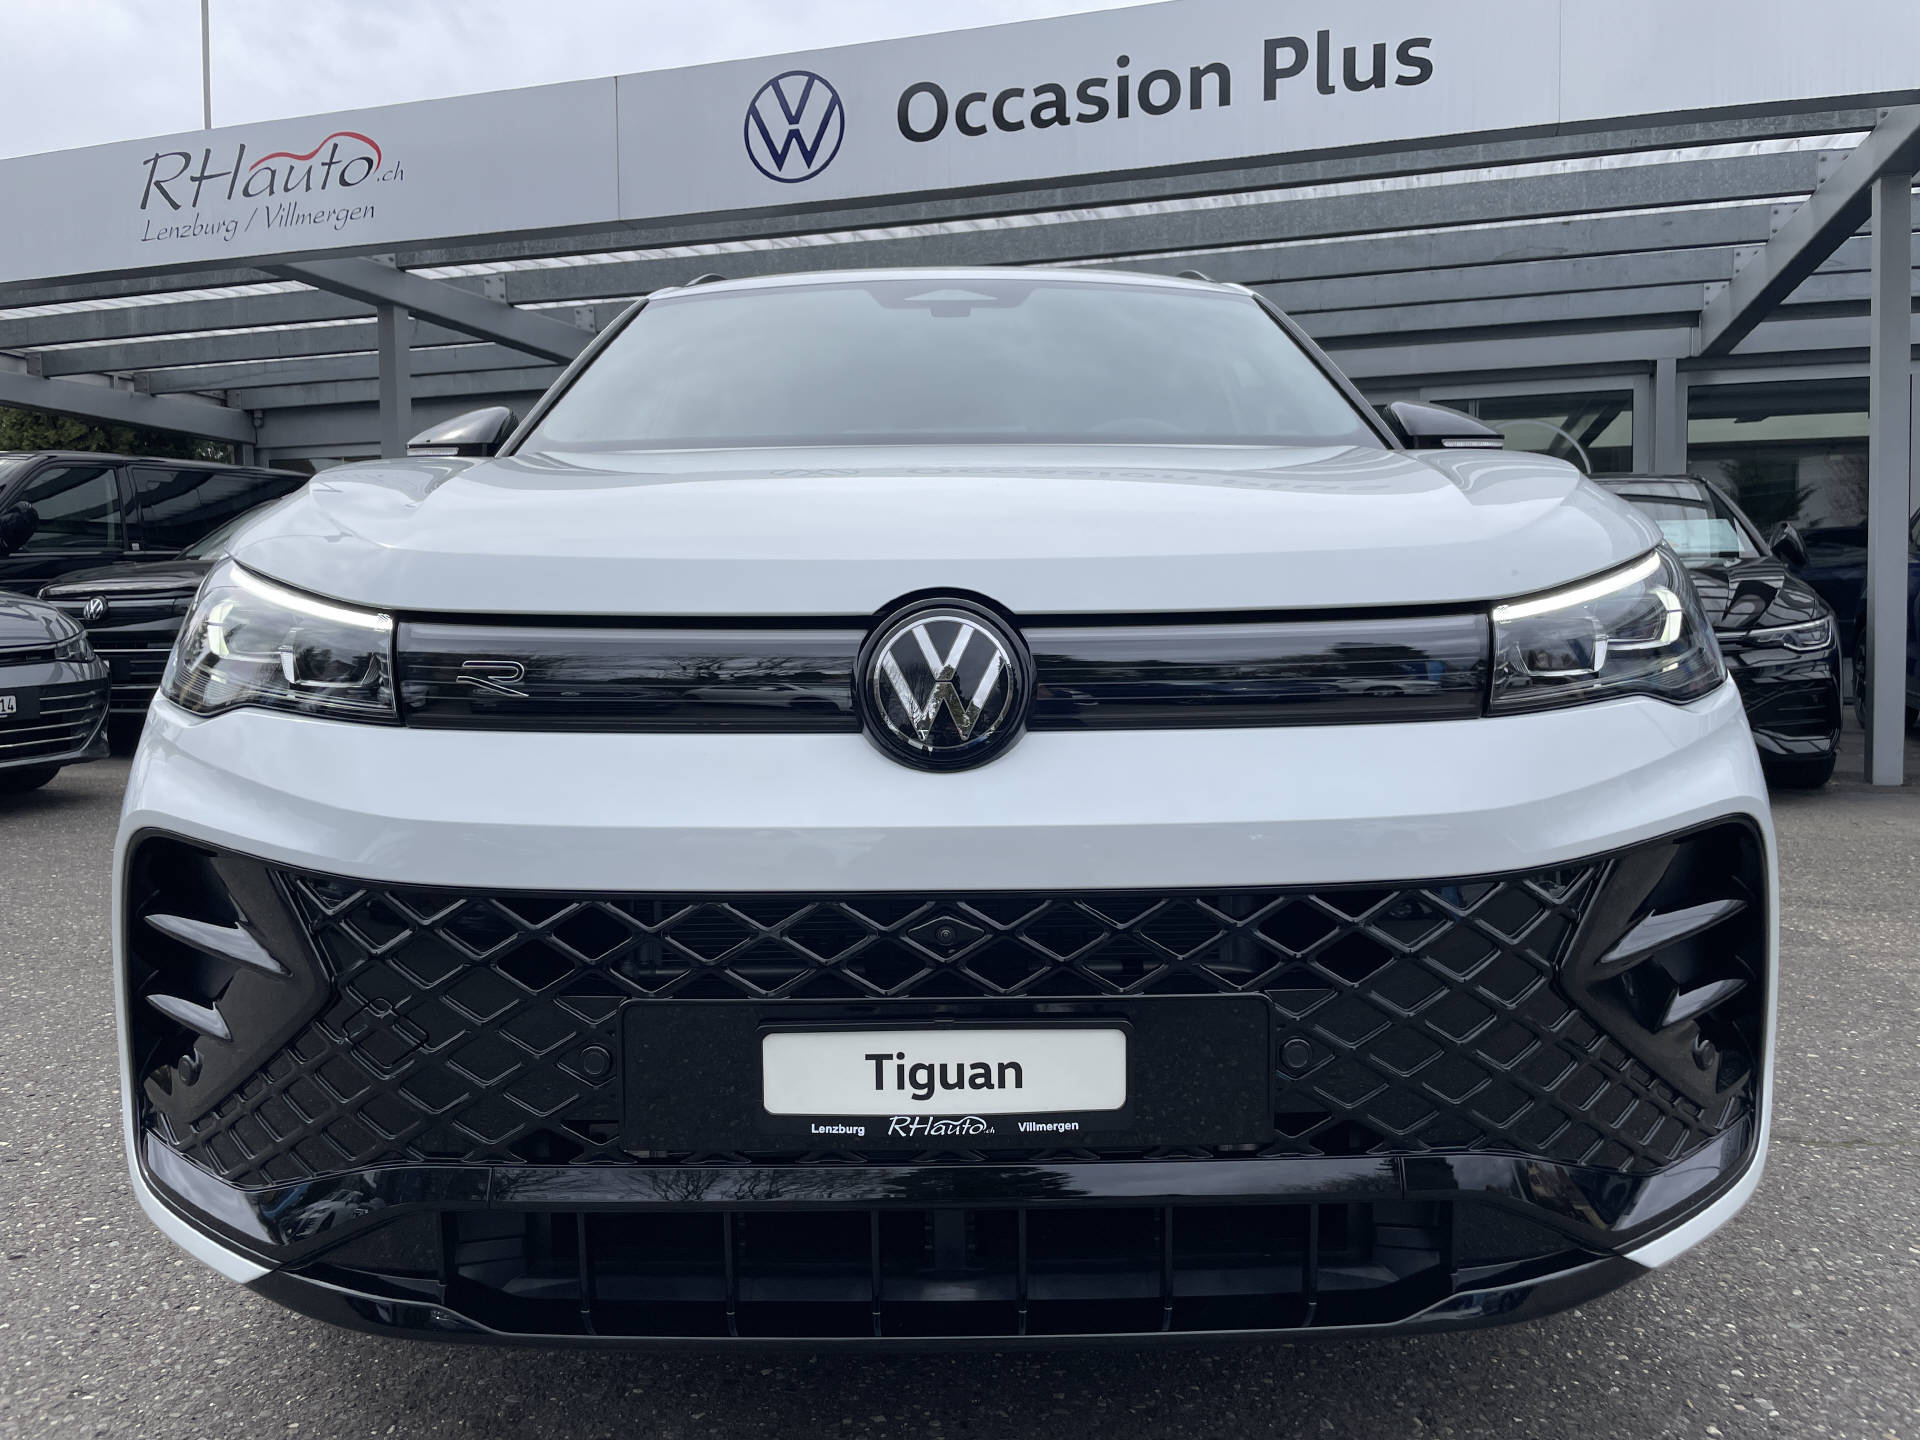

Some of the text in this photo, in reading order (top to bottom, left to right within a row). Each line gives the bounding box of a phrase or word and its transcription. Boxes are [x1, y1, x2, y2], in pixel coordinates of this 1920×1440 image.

[897, 29, 1433, 143] Occasion Plus
[141, 212, 239, 242] Lenzburg
[264, 201, 375, 230] Villmergen
[864, 1051, 1024, 1101] Tiguan
[811, 1123, 866, 1137] Lenzburg
[1017, 1120, 1079, 1133] Villmergen
